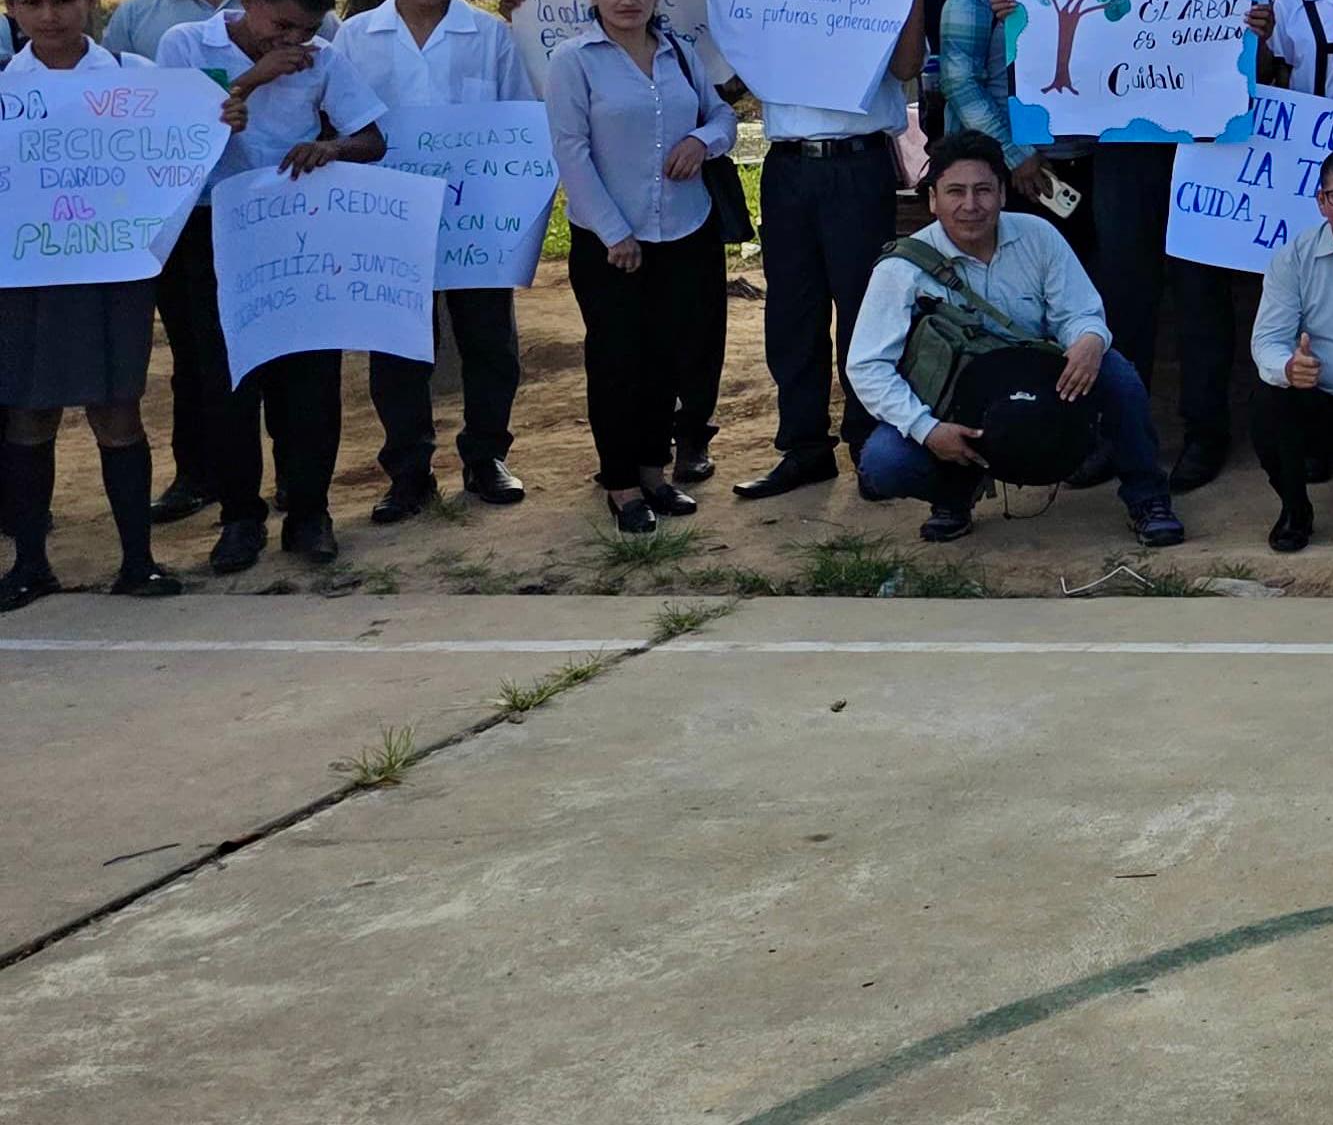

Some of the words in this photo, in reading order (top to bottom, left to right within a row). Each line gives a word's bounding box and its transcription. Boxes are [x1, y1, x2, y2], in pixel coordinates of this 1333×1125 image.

[729, 0, 753, 19] las
[762, 1, 818, 30] futuras
[1133, 30, 1156, 50] ES
[1172, 25, 1243, 46] SAGRADO
[1108, 63, 1184, 97] Cuidalo
[83, 88, 159, 118] VEZ
[19, 124, 211, 163] RECICLAS
[418, 128, 534, 152] RECICLAJE
[40, 165, 125, 189] DANDO
[147, 164, 206, 187] VIDA
[465, 159, 498, 176] EN
[505, 161, 554, 177] CASA
[1237, 147, 1274, 188] LA
[53, 195, 95, 222] AL
[328, 187, 408, 221] REDUCE
[448, 181, 464, 206] Y
[1177, 181, 1252, 222] CUIDA
[457, 213, 484, 230] EN
[495, 217, 520, 232] UN
[1253, 214, 1288, 249] LA
[13, 217, 163, 260] PLANET
[350, 252, 422, 282] JUNTOS
[444, 244, 489, 267] MÁS
[315, 283, 336, 303] EL
